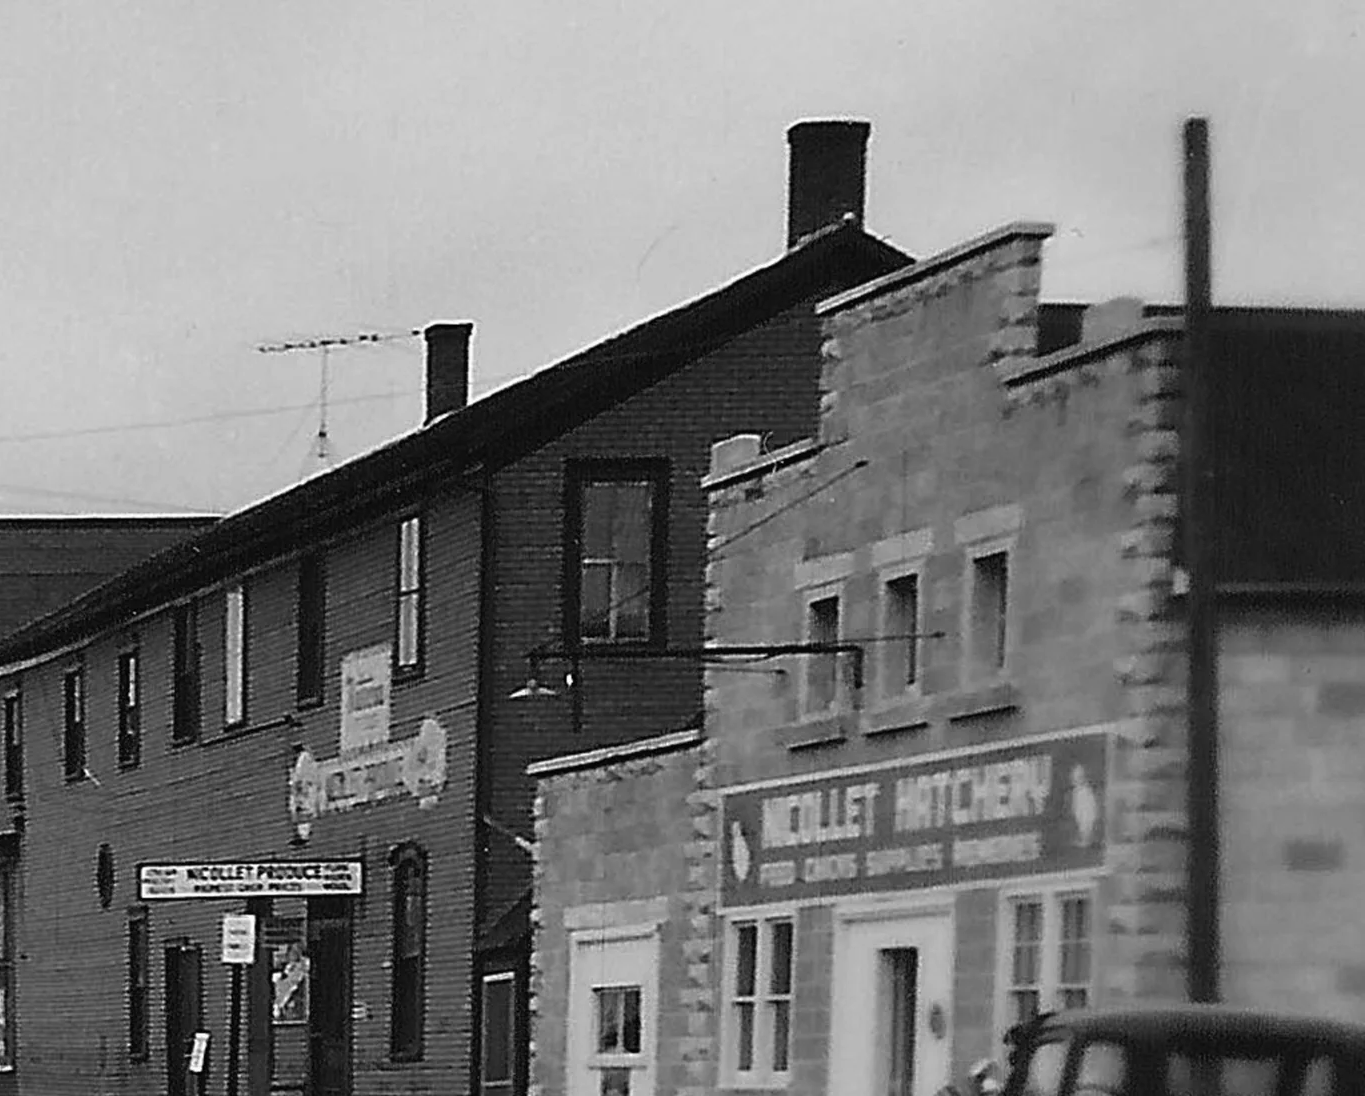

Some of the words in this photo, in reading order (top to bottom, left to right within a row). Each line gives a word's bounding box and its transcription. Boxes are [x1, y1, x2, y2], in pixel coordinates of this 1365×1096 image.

[762, 783, 880, 849] NICOLLET
[895, 754, 1053, 832] HATCHERY
[187, 865, 253, 881] NICOLLET
[257, 864, 321, 880] PRODUCE
